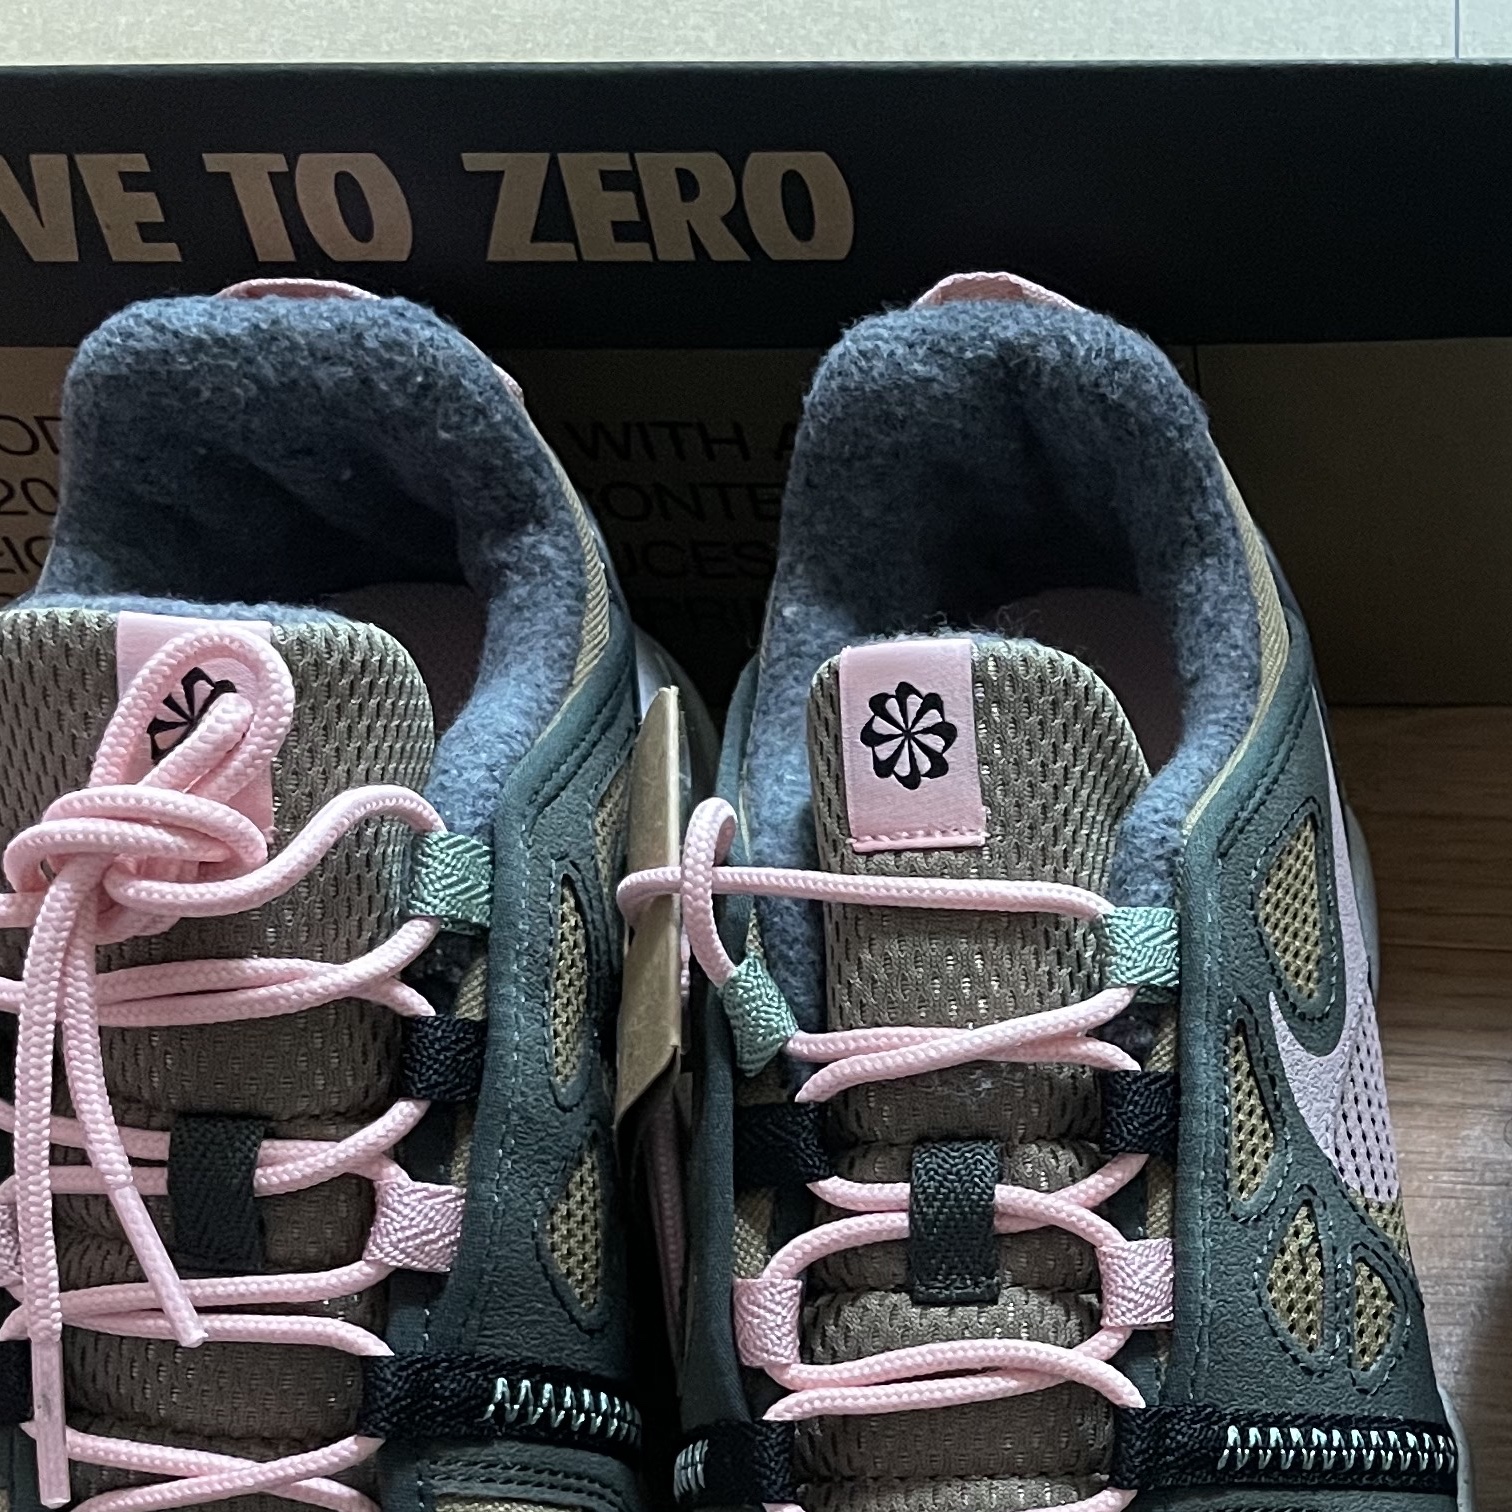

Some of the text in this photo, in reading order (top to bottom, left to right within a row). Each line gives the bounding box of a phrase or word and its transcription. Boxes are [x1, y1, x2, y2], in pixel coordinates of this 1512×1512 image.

[202, 153, 412, 262] TO
[461, 152, 854, 261] ZERO
[562, 419, 750, 462] WITH
